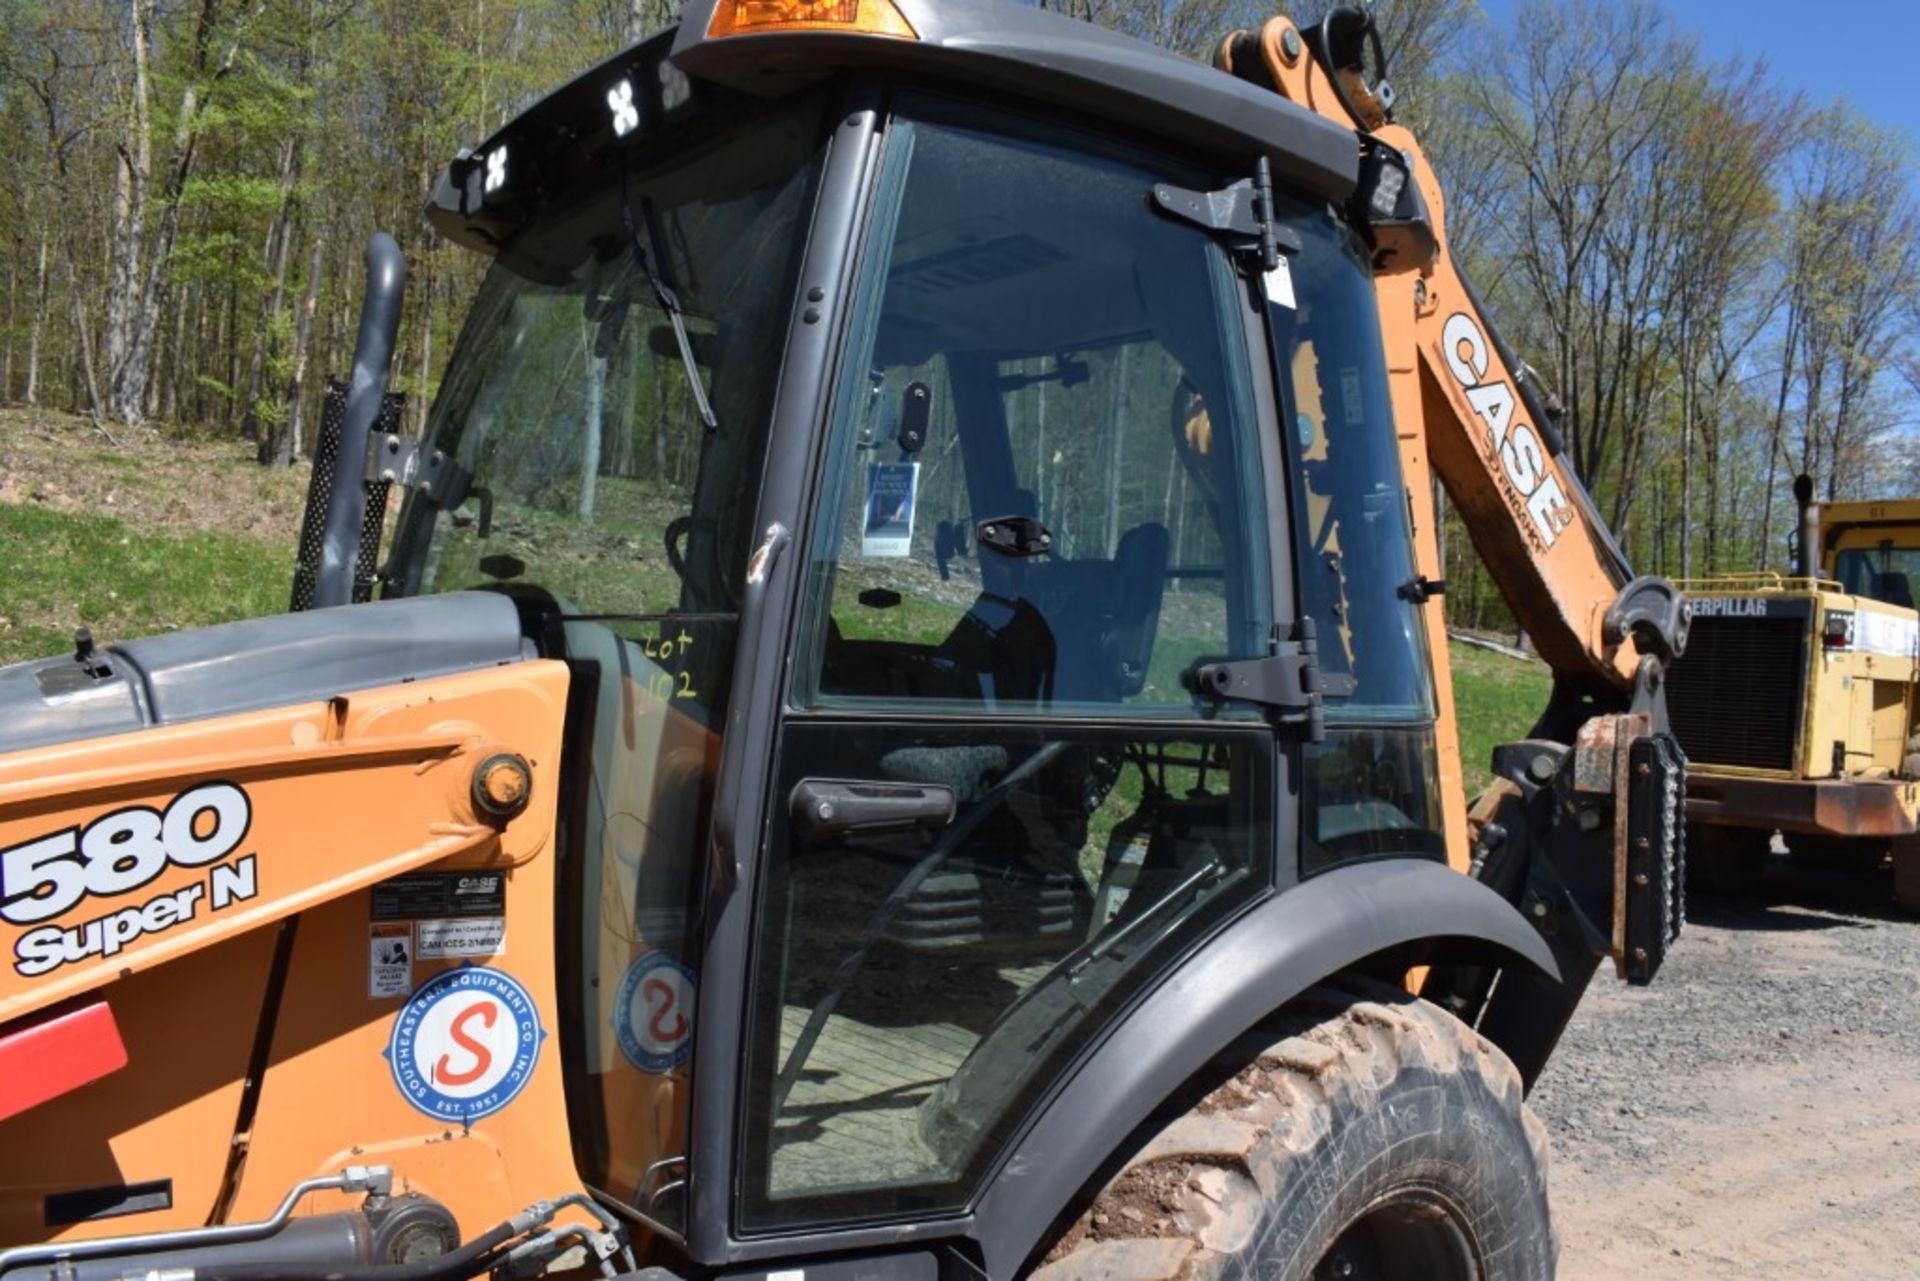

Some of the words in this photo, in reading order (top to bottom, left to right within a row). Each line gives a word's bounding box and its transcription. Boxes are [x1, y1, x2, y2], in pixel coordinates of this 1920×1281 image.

[1441, 312, 1573, 548] CASE
[1690, 597, 1767, 616] ERPILLAR
[0, 780, 252, 924] 580
[459, 877, 499, 888] CASE
[13, 880, 205, 976] Super
[210, 853, 258, 911] N
[451, 974, 527, 1015] EQUIPMENT
[436, 1001, 498, 1086] S
